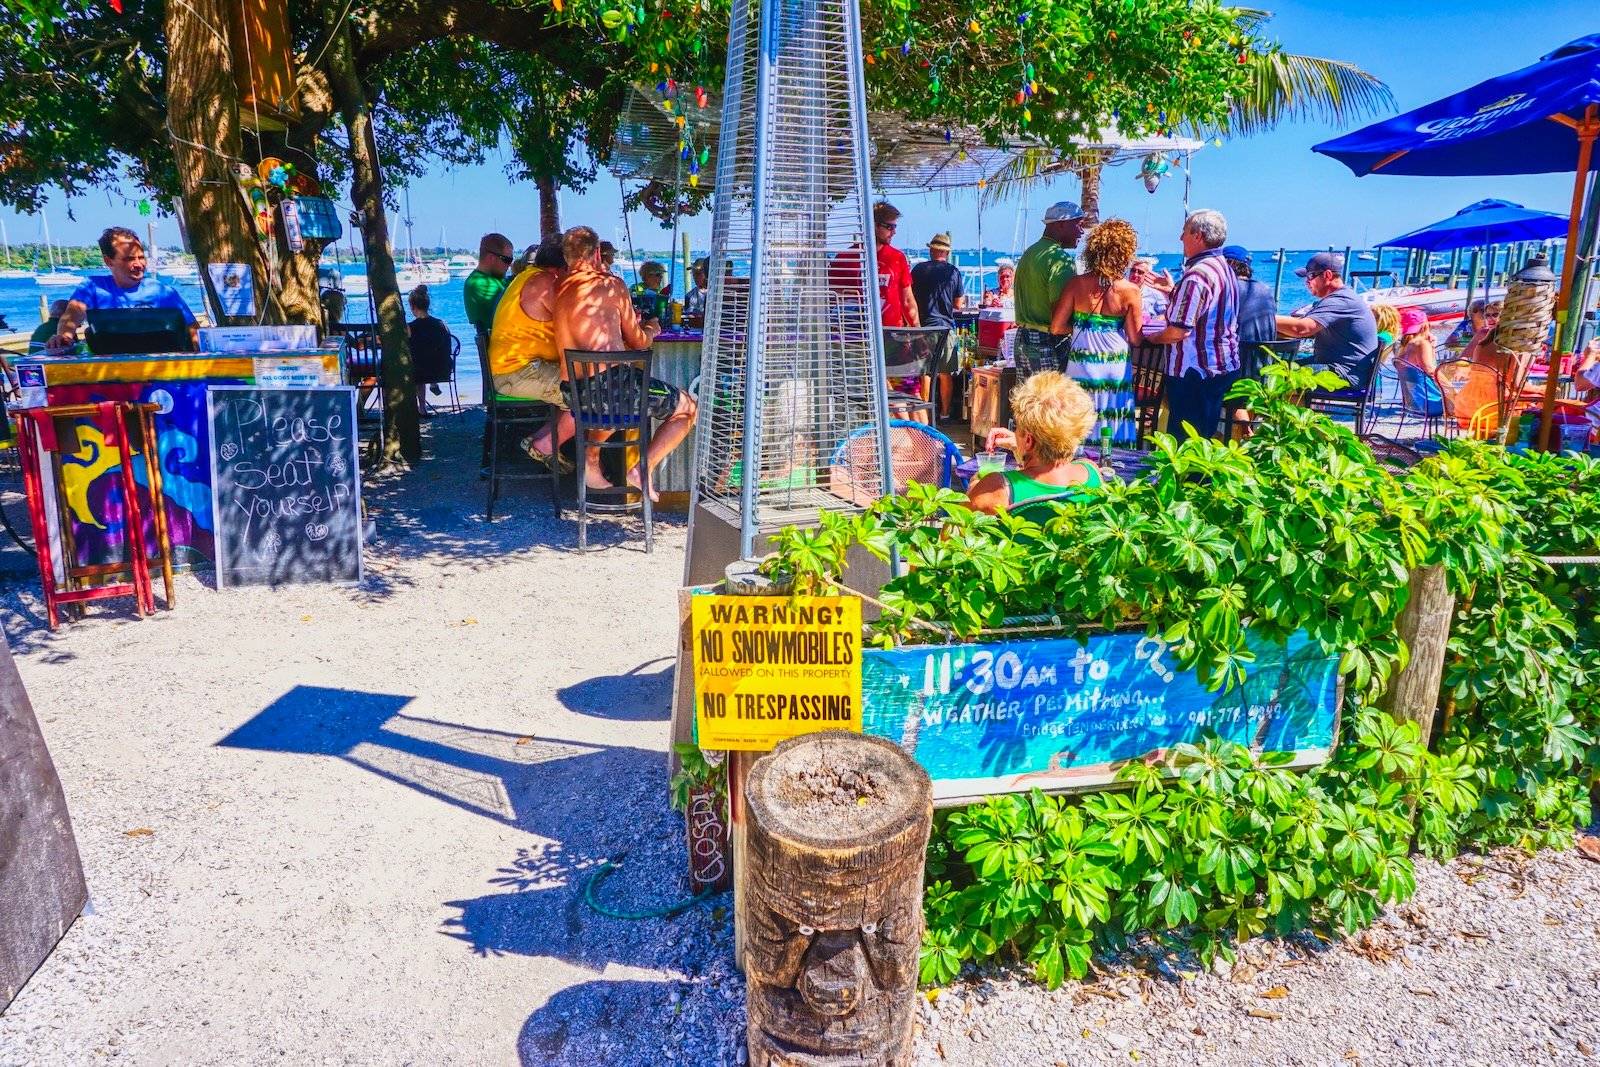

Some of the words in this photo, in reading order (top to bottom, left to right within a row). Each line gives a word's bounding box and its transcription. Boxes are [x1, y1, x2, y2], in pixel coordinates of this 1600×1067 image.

[1416, 98, 1537, 134] Corona
[234, 398, 346, 454] Please
[234, 451, 324, 489] Seat
[710, 604, 844, 625] WARNING!
[700, 629, 723, 663] NO
[732, 631, 853, 665] SNOWMOBILES
[703, 667, 753, 678] ALLOWED
[756, 668, 774, 678] ON
[779, 668, 799, 678] THIS
[803, 669, 851, 679] PROPERTY
[1067, 647, 1109, 684] to
[703, 693, 726, 718] NO
[735, 694, 851, 721] TRESPASSING
[922, 700, 1025, 726] WEATHER
